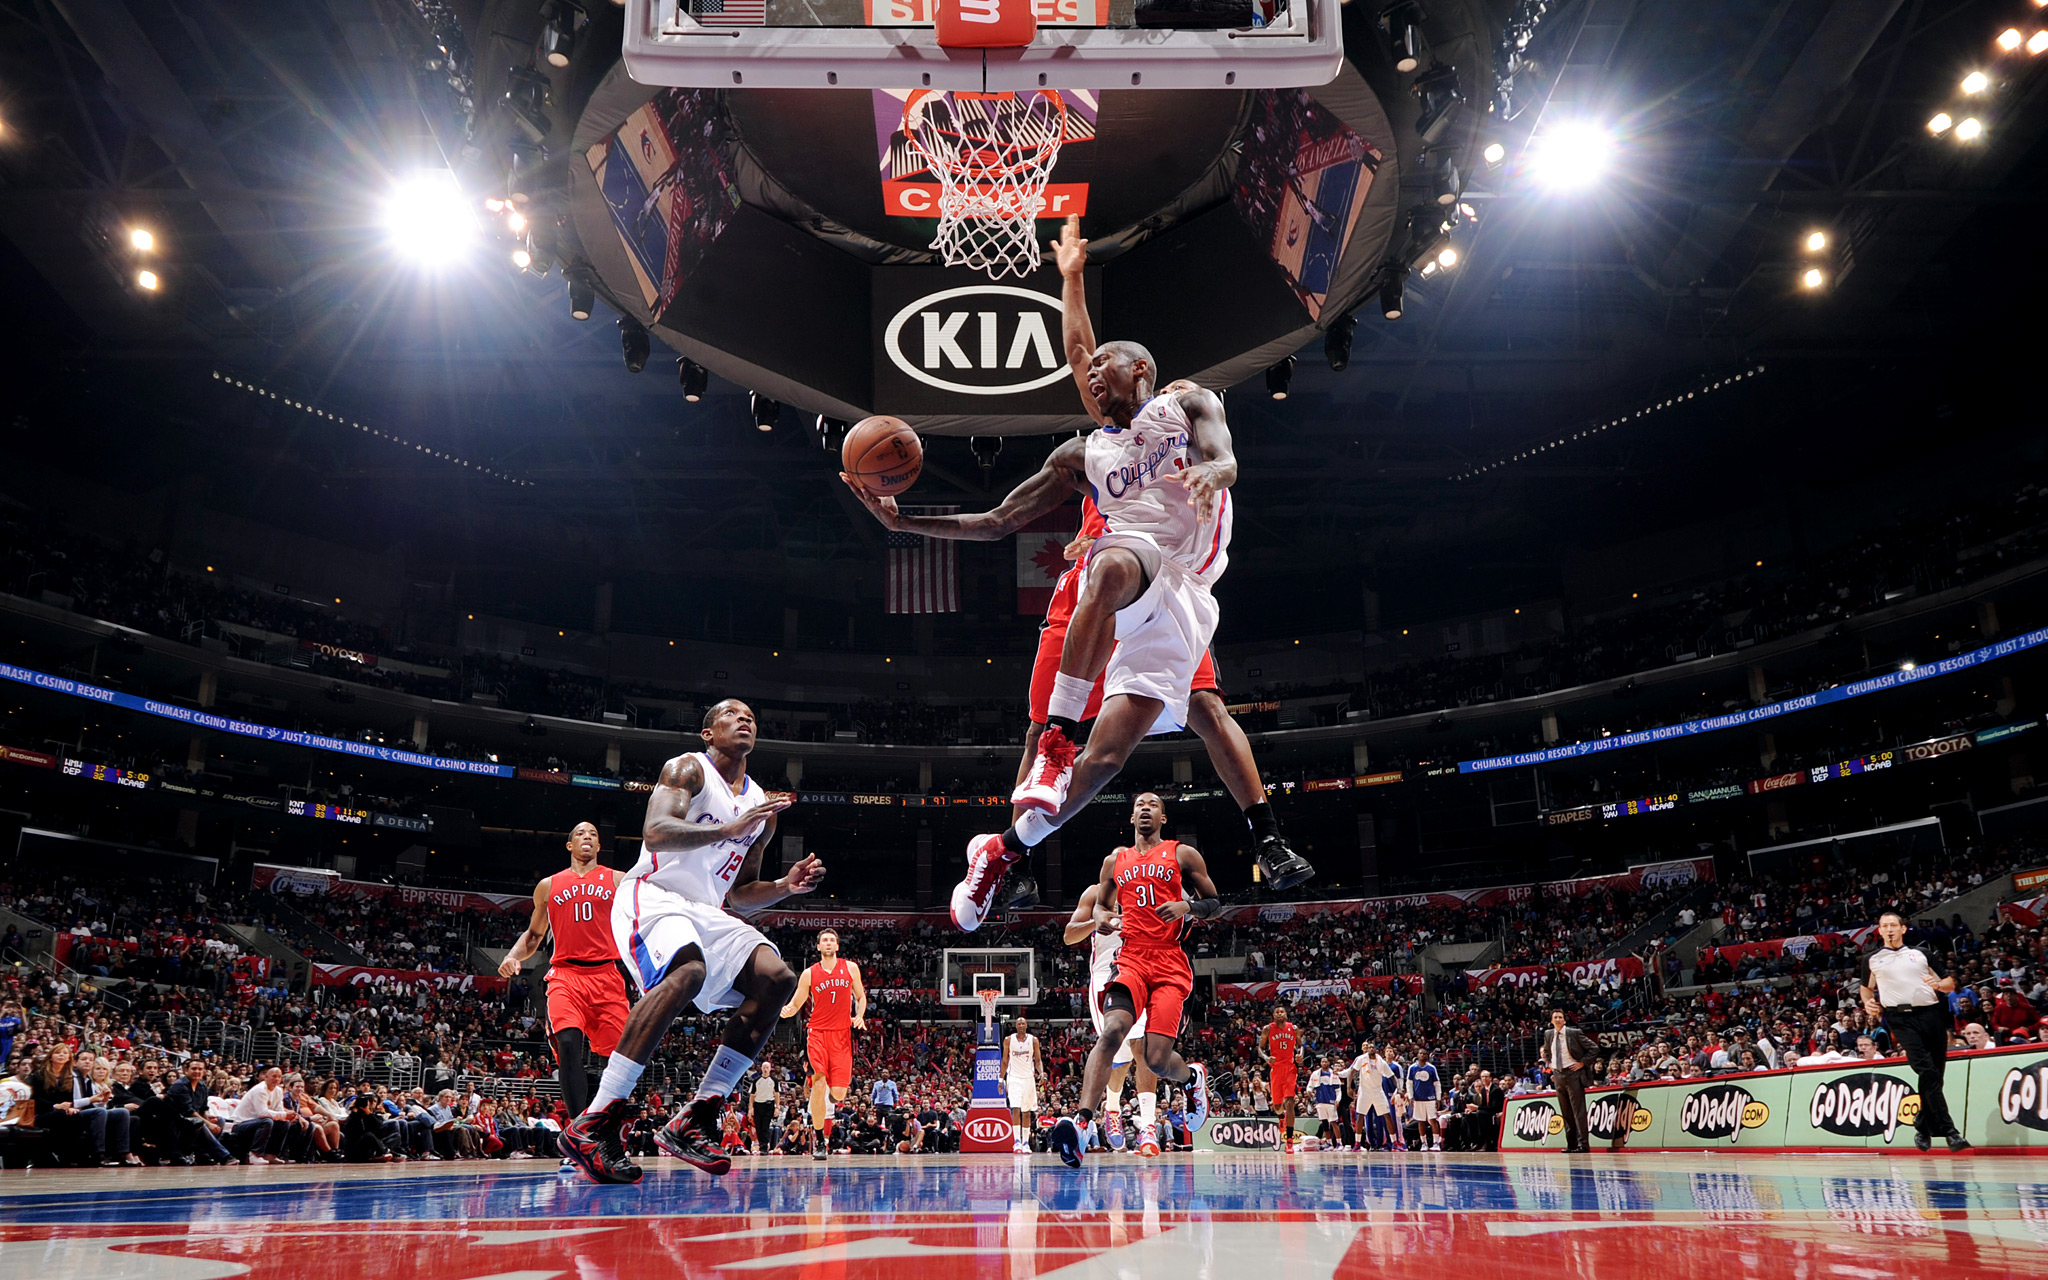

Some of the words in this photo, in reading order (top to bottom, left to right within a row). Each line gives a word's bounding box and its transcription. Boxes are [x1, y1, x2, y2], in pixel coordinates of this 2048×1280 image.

[921, 312, 1058, 368] KIA
[1106, 432, 1189, 498] Clippers
[1846, 675, 1896, 696] CHUMASH
[1898, 665, 1936, 683] CASINO
[1939, 653, 1976, 673] RESORT
[1995, 642, 2018, 656] JUST
[2018, 637, 2026, 648] 2
[35, 674, 74, 692] CASINO
[77, 684, 114, 702] RESORT
[144, 701, 190, 720] CHUMASH
[194, 712, 227, 728] CASINO
[229, 720, 264, 736] RESORT
[282, 731, 303, 743] JUST
[304, 735, 310, 744] 2
[312, 736, 343, 750] HOURS
[346, 742, 375, 756] NORTH
[391, 750, 432, 766] CHUMASH
[434, 758, 466, 770] CASINO
[468, 762, 500, 774] RESORT
[1471, 756, 1512, 770] CHUMASH
[1514, 752, 1545, 764] CASINO
[1548, 746, 1577, 760] RESORT
[1593, 738, 1612, 751] JUST
[1613, 737, 1619, 747] 2
[1620, 731, 1650, 746] HOURS
[1652, 724, 1683, 740] NORTH
[1700, 712, 1746, 730] CHUMASH
[1749, 704, 1781, 720] CASINO
[1784, 695, 1817, 712] RESORT
[1976, 728, 2009, 742] American
[2010, 721, 2039, 733] Express
[1905, 738, 1972, 760] TOYOTA
[1840, 760, 1850, 770] 17
[1870, 752, 1893, 762] 5:00
[62, 766, 82, 776] DEP
[93, 772, 104, 780] 32
[118, 777, 146, 789] NCAAB
[94, 764, 106, 773] 17
[126, 770, 150, 782] 5:00
[1812, 773, 1828, 782] DEP
[1864, 760, 1892, 772] NCAAB
[161, 782, 197, 794] Panasonic
[572, 777, 598, 786] American
[600, 780, 621, 788] Express
[1764, 772, 1797, 790] Coca-Cola
[853, 796, 892, 805] STAPLES
[934, 796, 946, 806] 97
[1688, 790, 1704, 800] SAN
[1708, 784, 1742, 796] MANUEL
[288, 800, 305, 808] KNT
[1602, 804, 1617, 812] KNT
[1654, 794, 1678, 804] 11:40
[1628, 807, 1638, 815] 33
[1649, 802, 1674, 812] NCAAB
[336, 814, 362, 824] NCAAB
[388, 817, 426, 830] DELTA
[1549, 810, 1592, 825] STAPLES
[715, 850, 743, 882] 12
[1116, 864, 1175, 888] RAPTORS
[402, 888, 466, 907] EPRESENT
[554, 884, 612, 907] RAPTORS
[1136, 884, 1156, 908] 31
[574, 902, 594, 922] 10
[777, 917, 796, 927] LOS
[799, 918, 846, 928] ANGELES
[848, 918, 897, 928] CLIPPERS
[815, 979, 850, 994] RAPTORS
[830, 991, 836, 1004] 7
[1280, 1041, 1288, 1050] 15
[976, 1072, 1000, 1080] RESORT
[1898, 1103, 1920, 1116] .CO
[972, 1122, 1005, 1138] KIA
